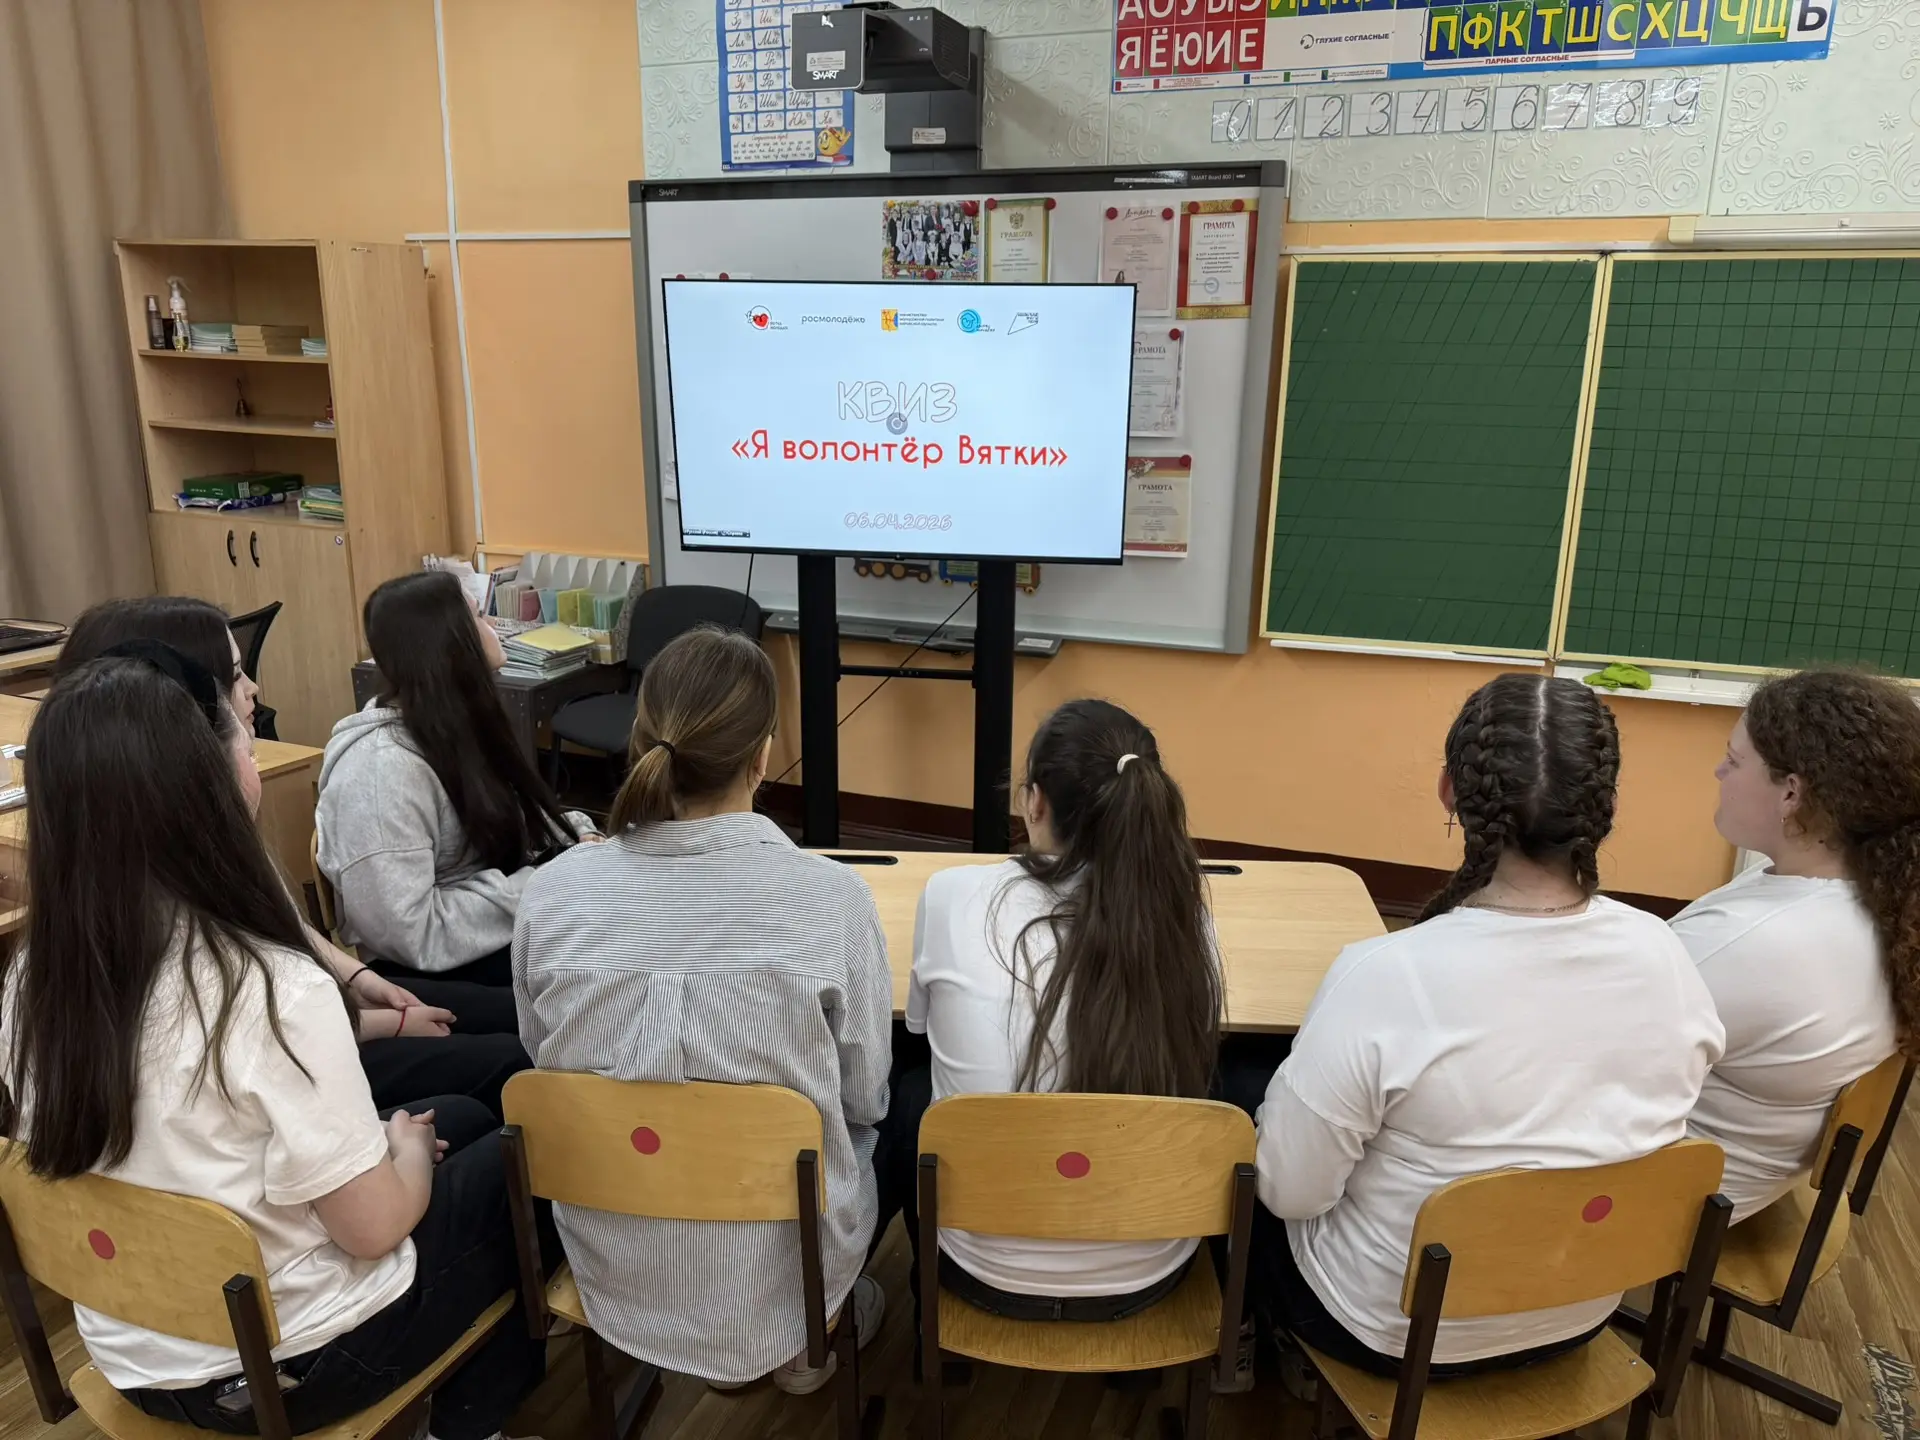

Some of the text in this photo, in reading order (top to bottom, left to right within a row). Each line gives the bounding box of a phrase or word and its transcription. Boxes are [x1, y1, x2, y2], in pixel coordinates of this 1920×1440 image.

[1429, 15, 1458, 51] П
[1463, 13, 1493, 49] Ф
[1499, 11, 1525, 47] К
[1536, 8, 1562, 44] Т
[1567, 6, 1601, 43] Ш
[1607, 4, 1635, 41] С
[1641, 2, 1672, 39] Х
[1677, 1, 1708, 42] Ц
[1720, 0, 1748, 35] Ч
[1752, 0, 1786, 38] Щ
[1315, 33, 1389, 44] ГЛУХИЕ СОГЛАСНЫЕ
[1119, 28, 1258, 70] Я Ё Ю И Е
[1520, 54, 1570, 63] СОГЛАСНЫЕ
[812, 70, 839, 80] SMART
[1226, 78, 1699, 141] 0 1 2 3 4 5 6 7 8 9
[658, 188, 679, 197] SMART
[1203, 221, 1236, 231] ГРАМОТА
[1001, 230, 1034, 239] ГРАМОТА
[801, 314, 866, 325] росмолодёжь
[837, 380, 958, 423] КВИЗ
[731, 429, 1068, 469] «Я волонтёр Вятки»
[843, 511, 953, 531] 06.04.2026
